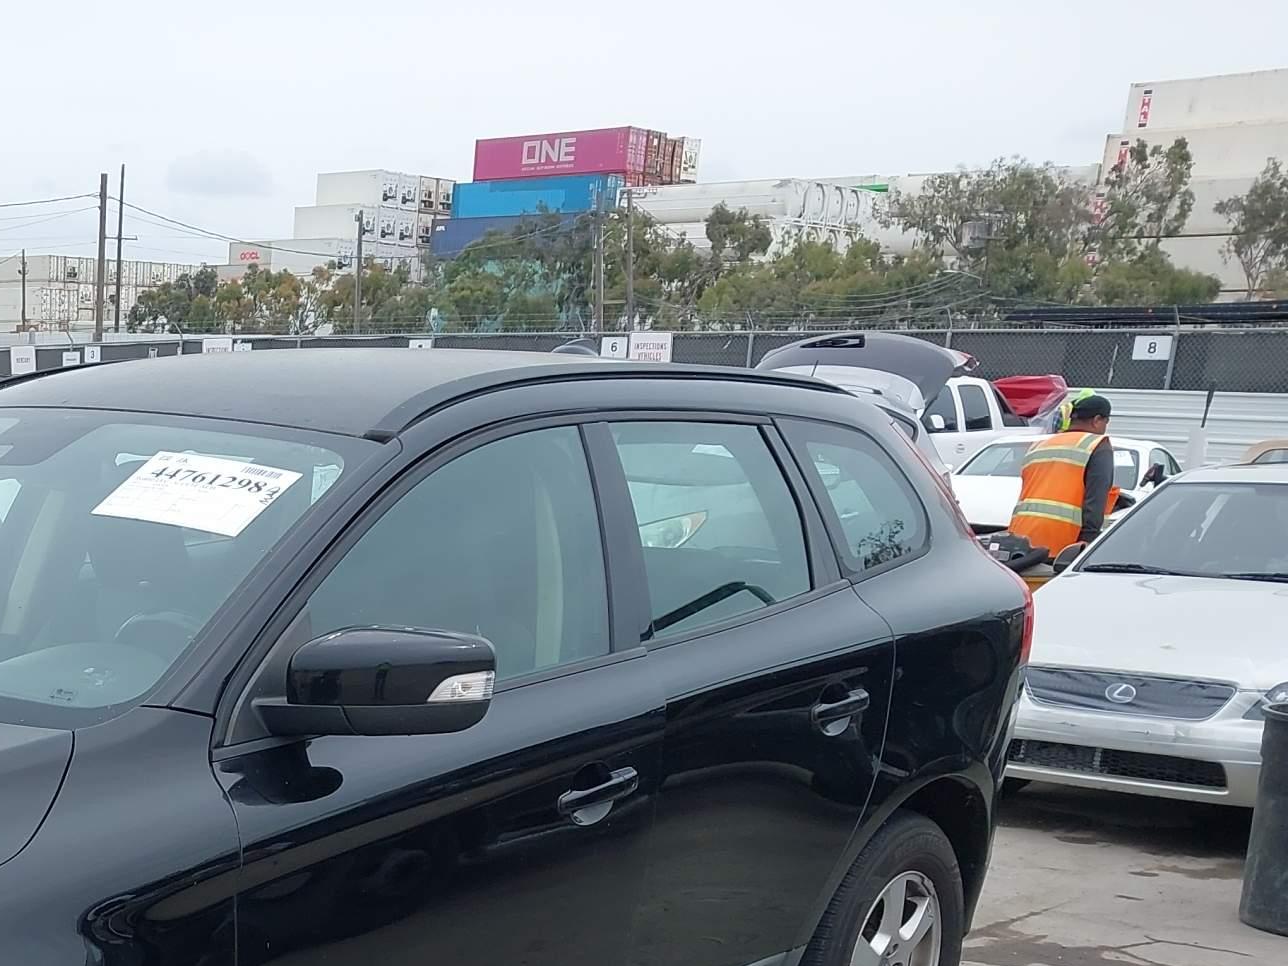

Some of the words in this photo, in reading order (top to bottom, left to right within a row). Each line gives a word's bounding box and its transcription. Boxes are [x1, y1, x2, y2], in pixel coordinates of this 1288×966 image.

[522, 138, 576, 164] ONE
[240, 251, 260, 261] OOCL
[610, 342, 618, 352] 6
[1148, 341, 1157, 354] 8
[152, 466, 268, 493] 44761298
